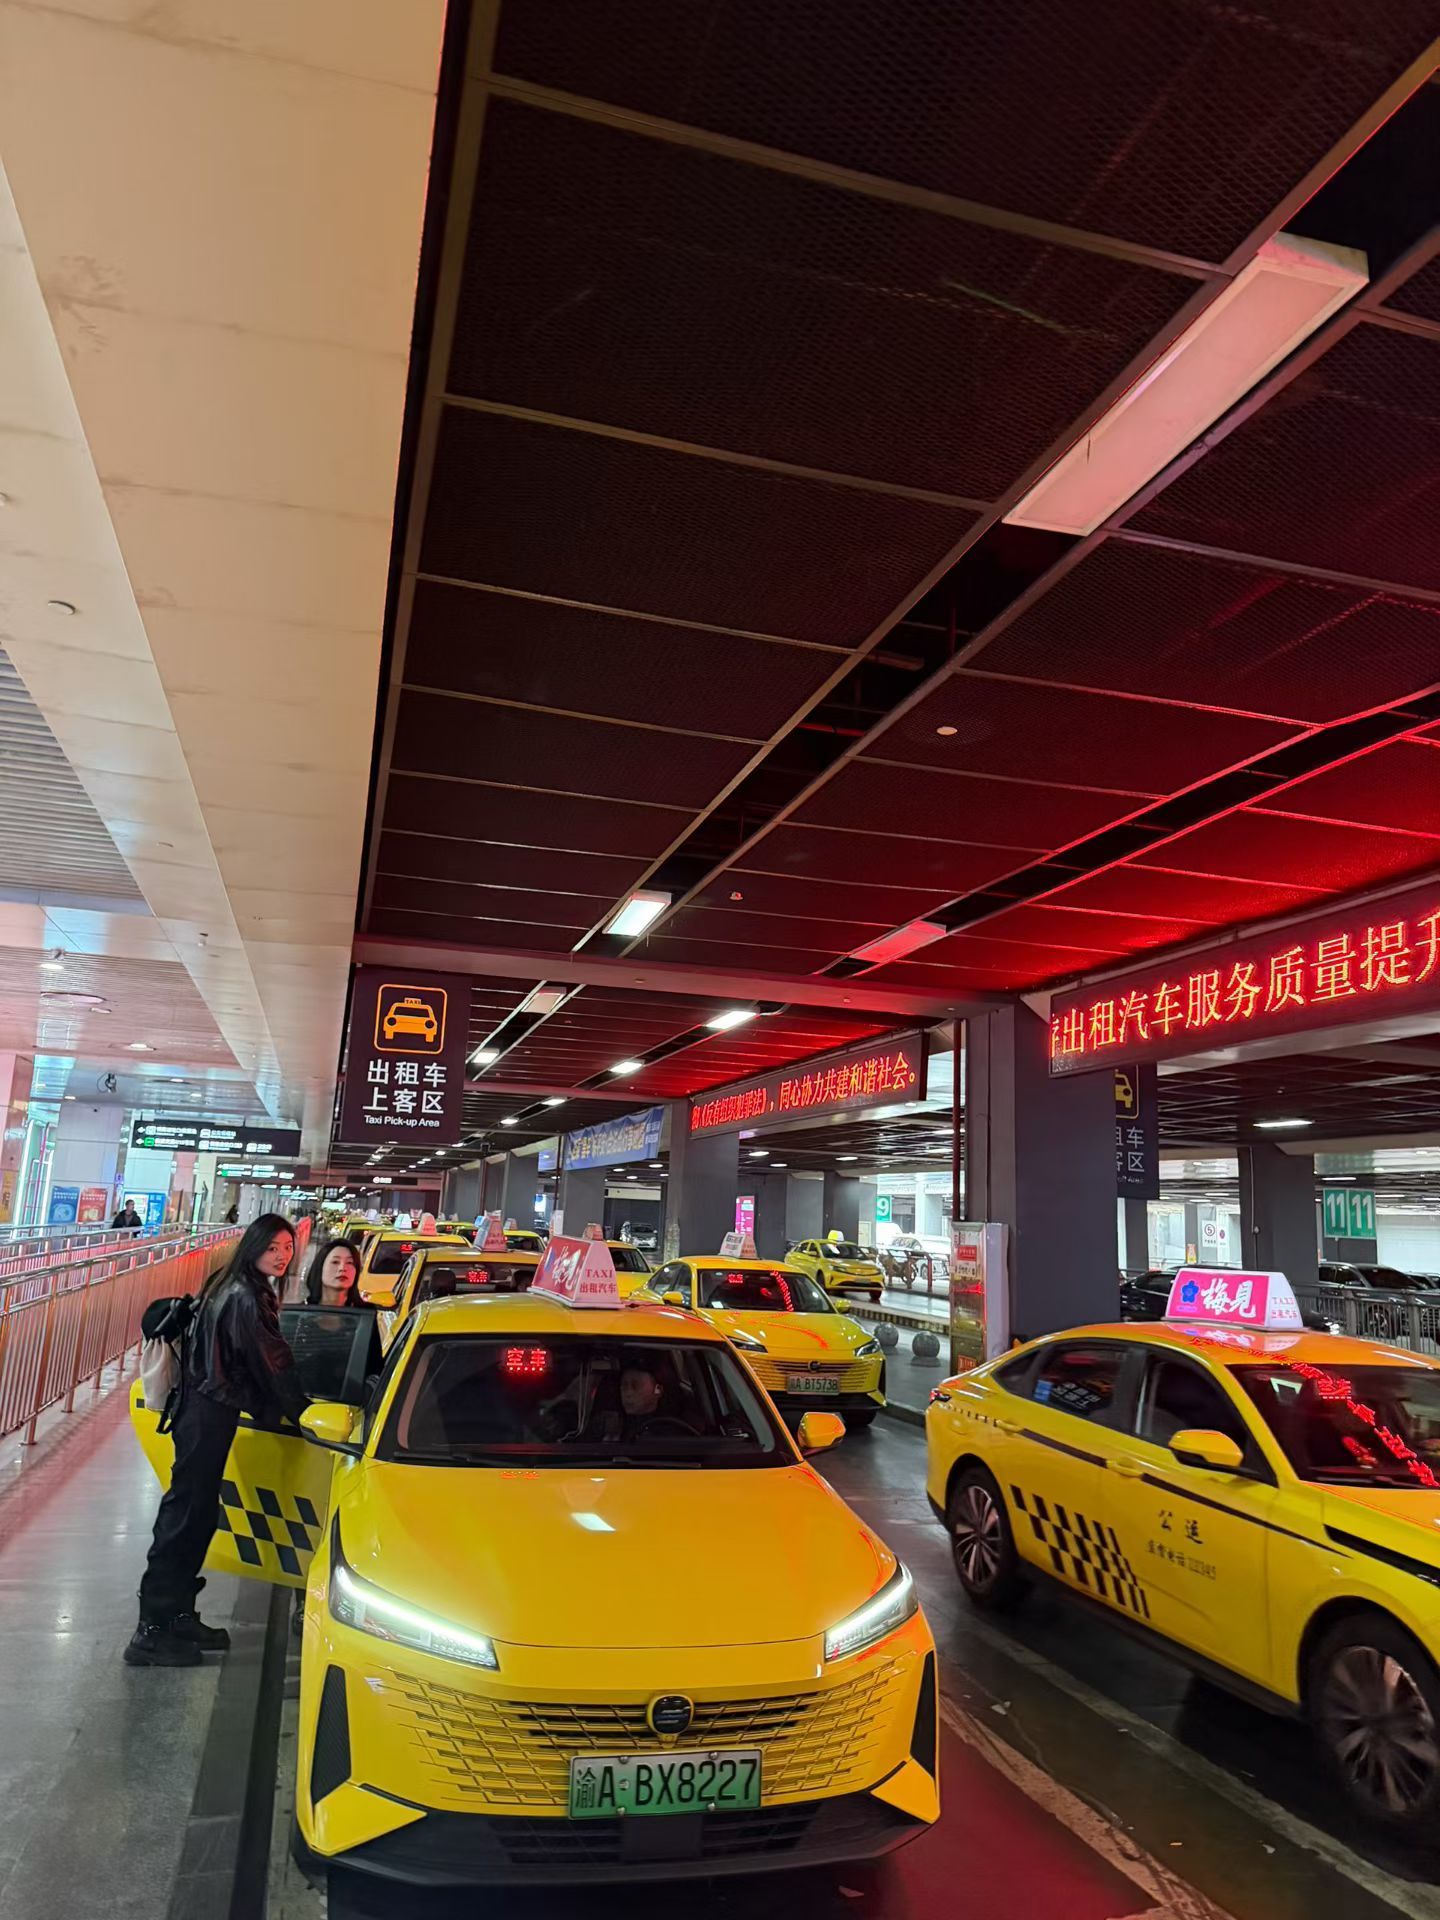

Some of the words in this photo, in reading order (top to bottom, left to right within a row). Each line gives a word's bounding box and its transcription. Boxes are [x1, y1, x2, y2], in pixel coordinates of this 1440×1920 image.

[367, 1058, 447, 1088] 出租车
[362, 1086, 445, 1114] 上客区
[364, 1115, 383, 1124] Taxi
[384, 1115, 418, 1127] Pick-up
[418, 1117, 440, 1127] Area
[876, 1197, 889, 1217] 9
[1327, 1193, 1345, 1228] 11
[1351, 1194, 1373, 1229] 11
[585, 1269, 613, 1279] TAXI
[580, 1283, 616, 1294] 出租汽车
